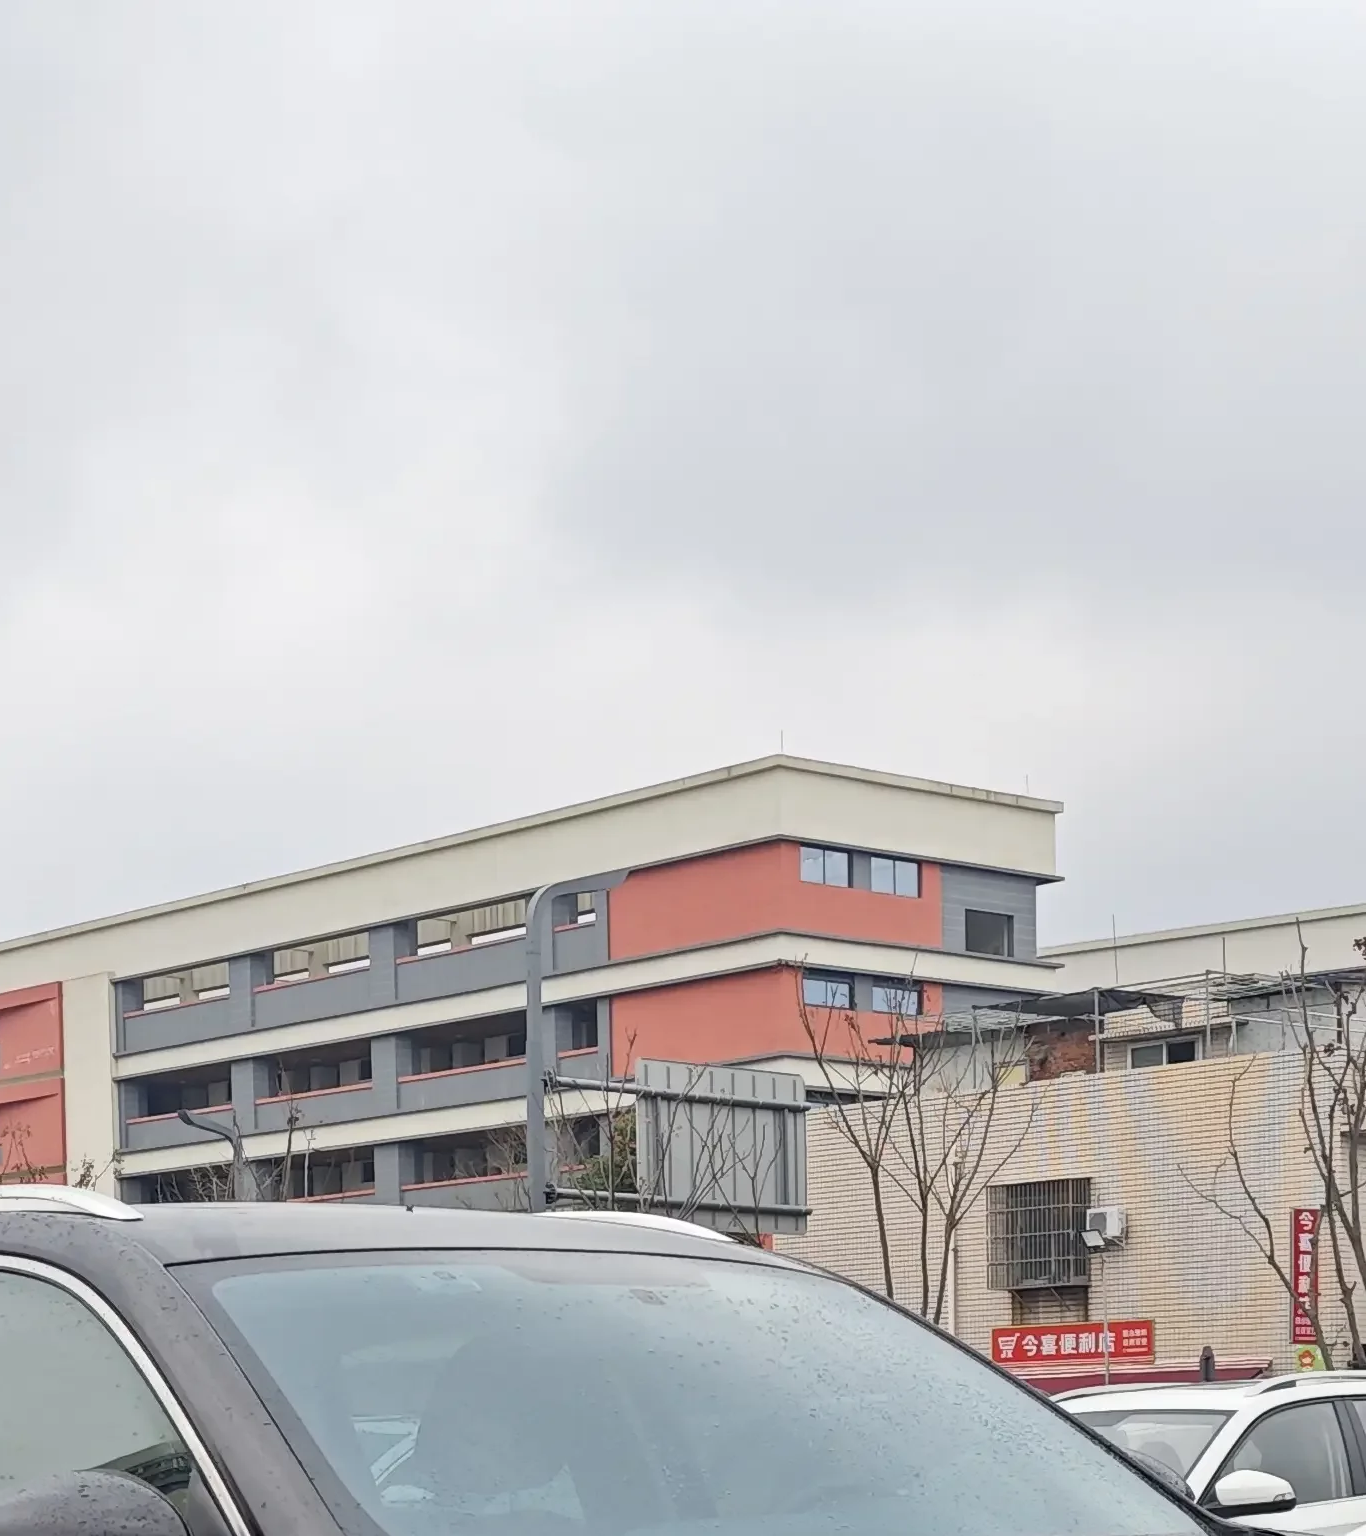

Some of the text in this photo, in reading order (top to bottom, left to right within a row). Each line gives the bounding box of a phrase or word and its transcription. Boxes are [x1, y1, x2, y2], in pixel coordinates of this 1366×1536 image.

[1022, 1332, 1115, 1357] 今喜便利店
